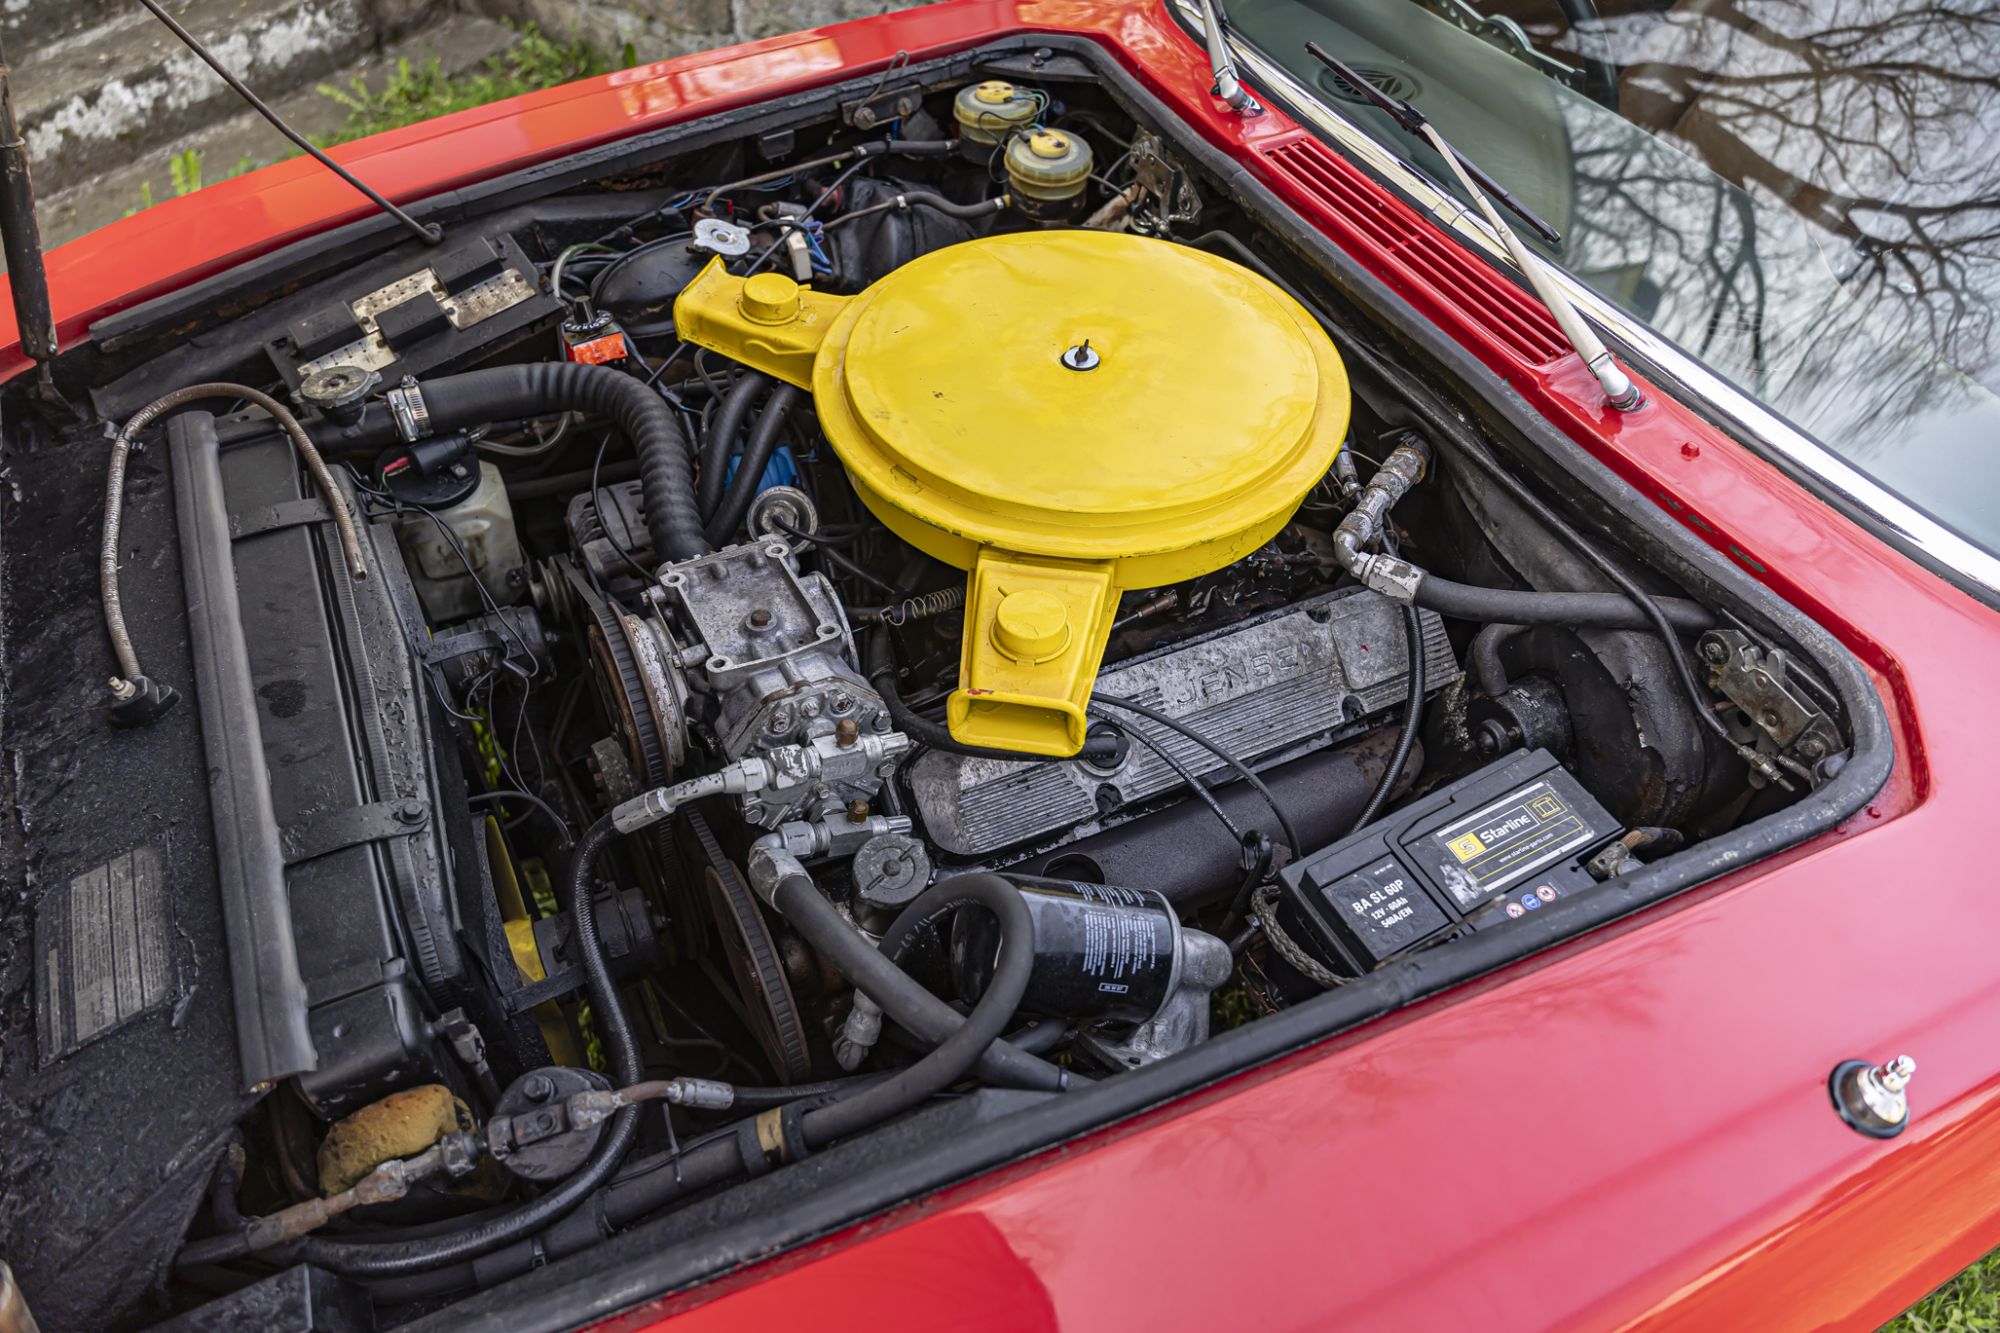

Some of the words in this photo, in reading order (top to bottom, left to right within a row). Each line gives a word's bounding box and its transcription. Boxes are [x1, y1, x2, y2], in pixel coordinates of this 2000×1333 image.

[1176, 637, 1321, 705] JENSEN
[1479, 814, 1532, 844] Starline
[1351, 897, 1373, 914] BA
[1369, 890, 1388, 904] SL
[1383, 878, 1404, 896] 60P
[1370, 907, 1386, 920] 12V
[1387, 896, 1409, 911] 60Ah
